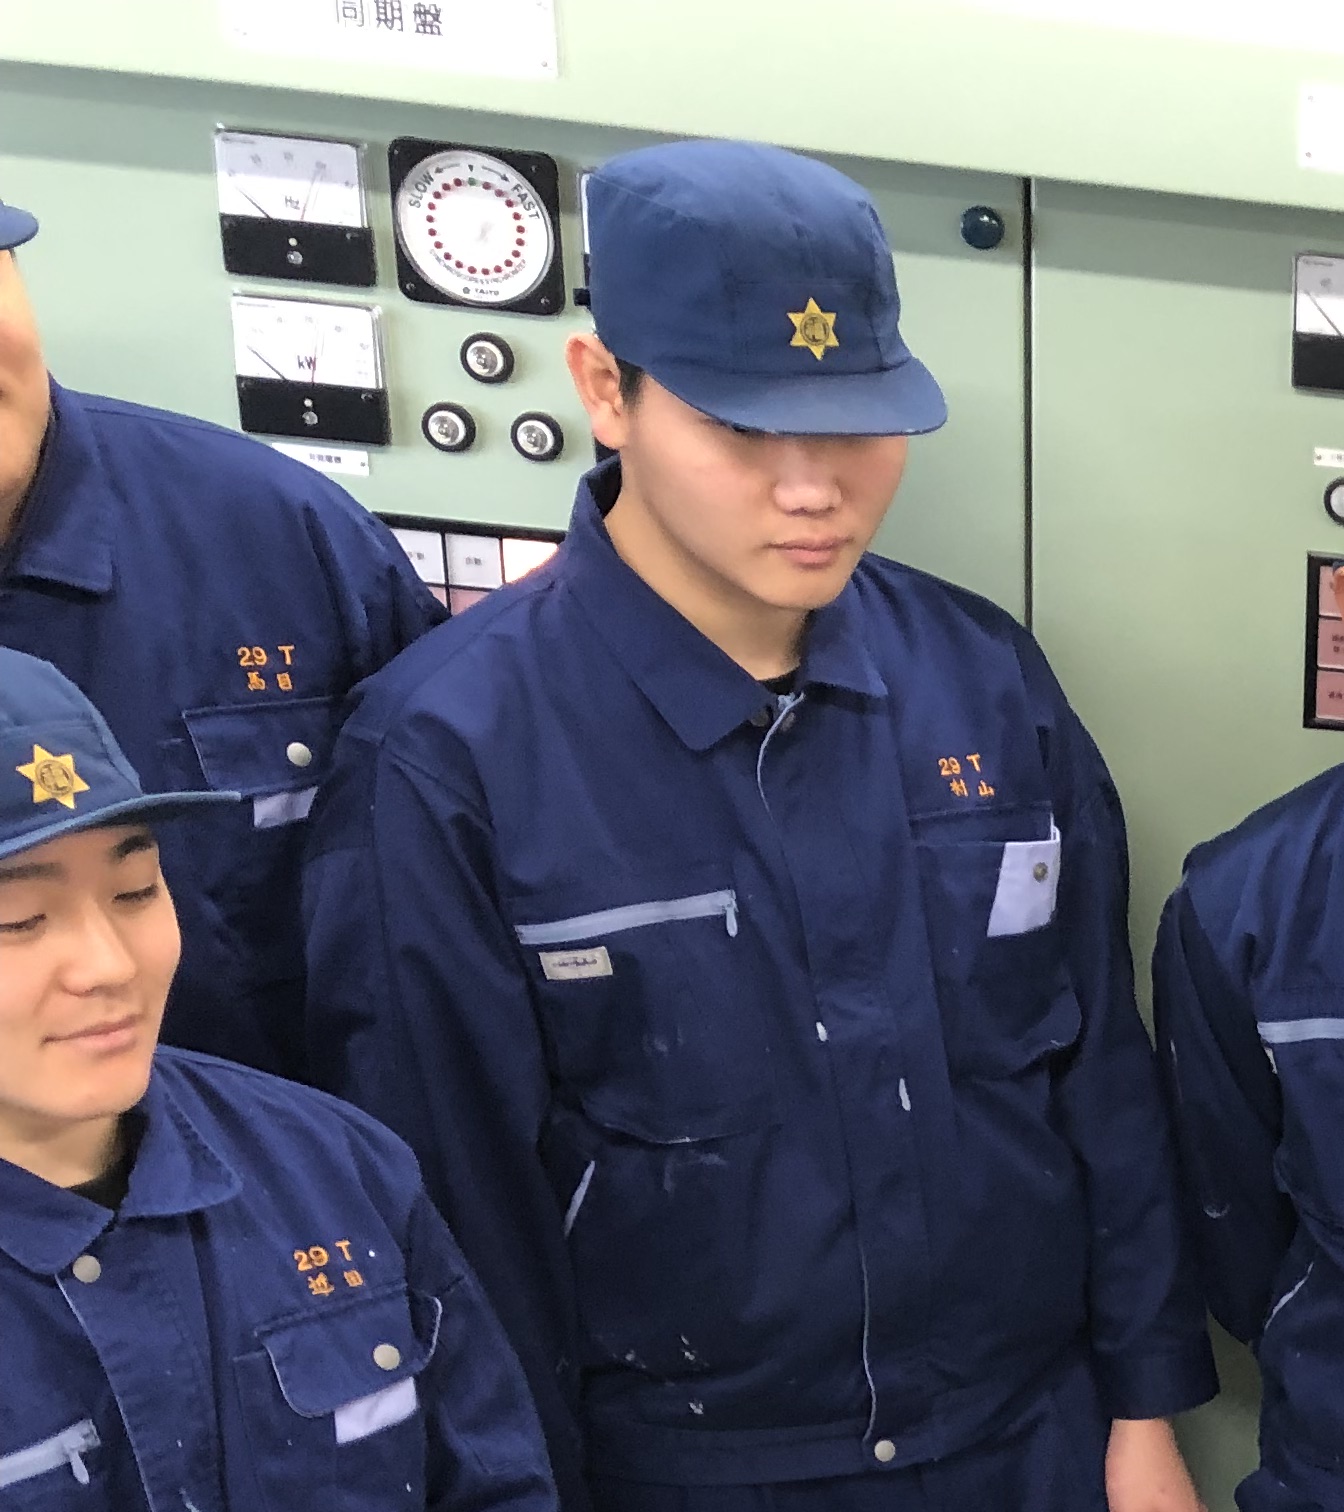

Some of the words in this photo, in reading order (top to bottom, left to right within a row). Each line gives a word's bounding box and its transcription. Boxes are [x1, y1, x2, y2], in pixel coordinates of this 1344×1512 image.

[408, 171, 434, 209] SLOW
[510, 183, 541, 221] FAST
[237, 646, 267, 667] 29
[277, 644, 295, 666] T
[938, 756, 961, 776] 29
[965, 752, 981, 773] T
[293, 1245, 329, 1272] 29
[334, 1239, 352, 1262] T
